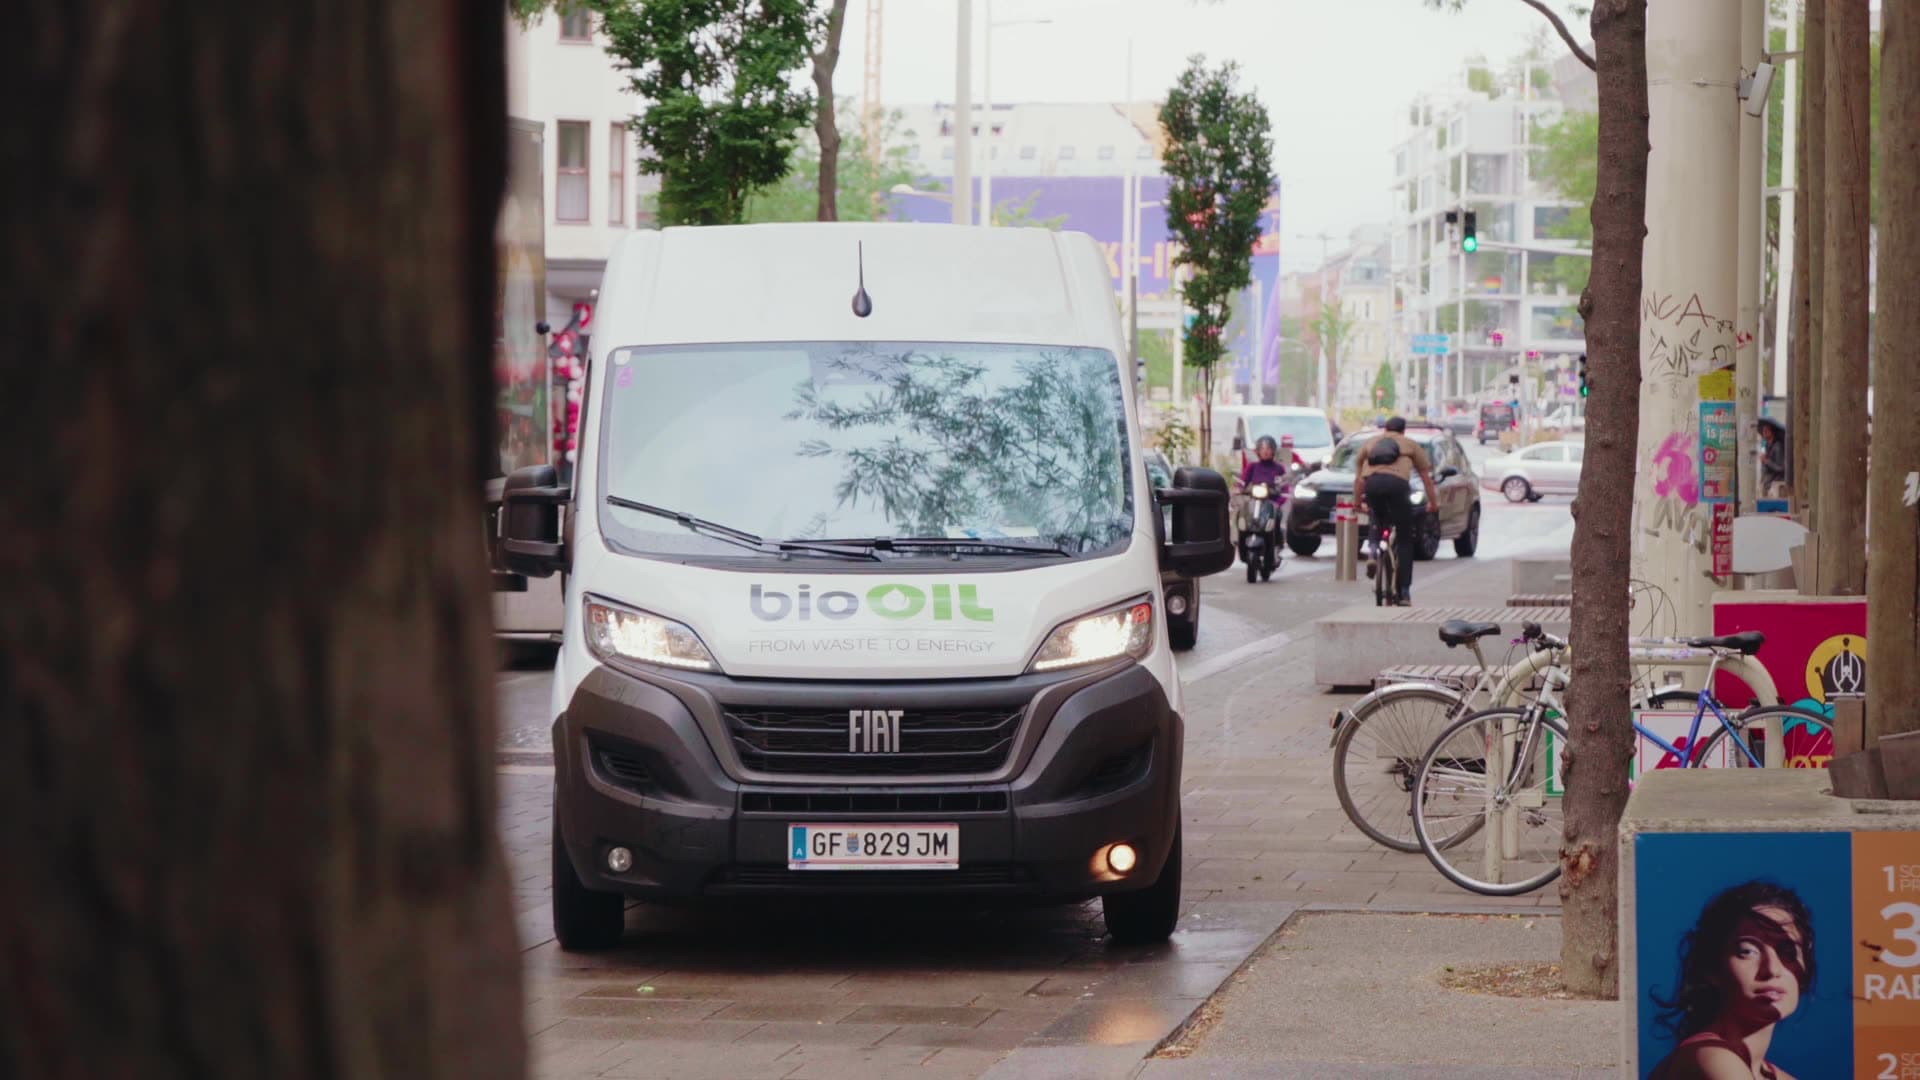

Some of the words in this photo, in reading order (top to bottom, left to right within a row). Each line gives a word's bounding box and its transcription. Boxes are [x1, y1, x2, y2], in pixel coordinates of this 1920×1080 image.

[750, 640, 806, 652] FROM
[812, 638, 878, 651] WASTE
[885, 638, 910, 650] TO
[917, 639, 995, 653] ENERGY
[849, 710, 904, 752] FIAT
[812, 832, 842, 856] GF
[864, 832, 910, 856] 829
[916, 832, 949, 856] JM
[1881, 865, 1895, 892] 1
[1880, 902, 1920, 968] 3
[1876, 1053, 1899, 1080] 2
